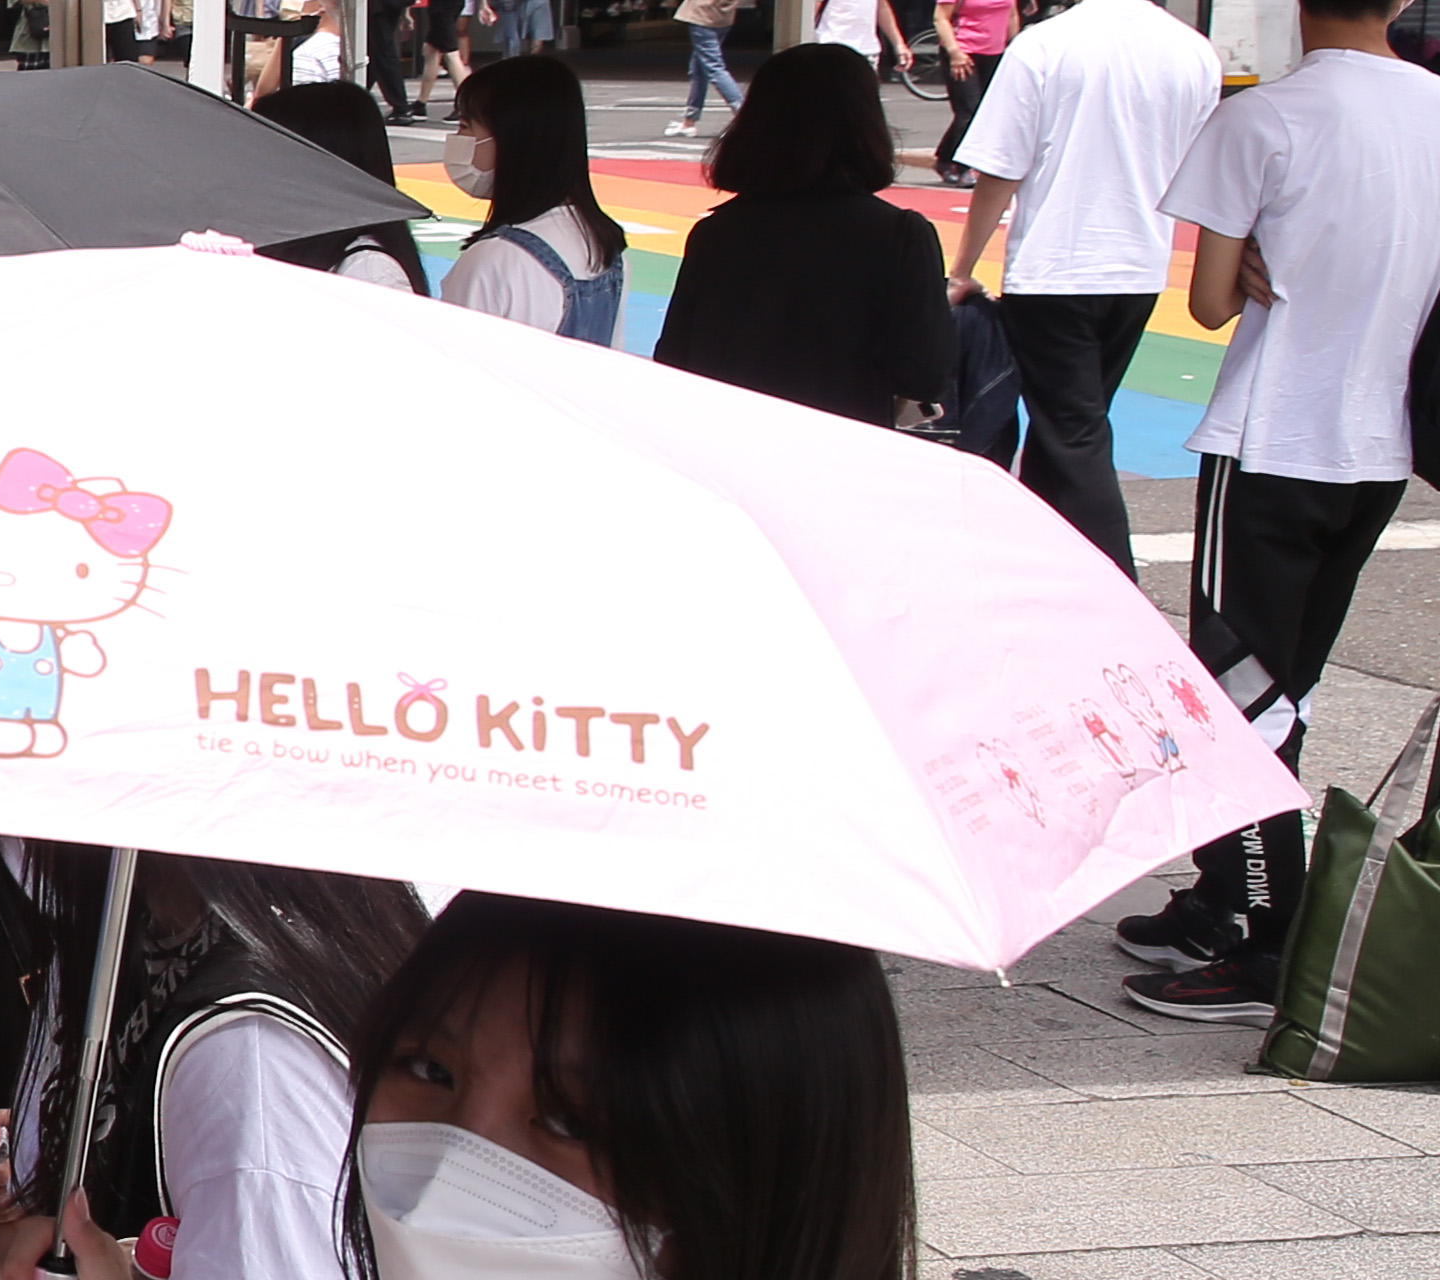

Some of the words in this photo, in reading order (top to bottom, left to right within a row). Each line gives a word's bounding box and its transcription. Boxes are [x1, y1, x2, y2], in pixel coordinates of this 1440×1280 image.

[194, 666, 449, 743] HELLO
[194, 731, 234, 755] tie
[243, 738, 263, 757] a
[271, 737, 331, 764] bow
[339, 746, 418, 776] when
[426, 760, 479, 786] you
[486, 766, 564, 795] meet
[573, 776, 709, 812] someone
[1245, 857, 1272, 910] DUNK
